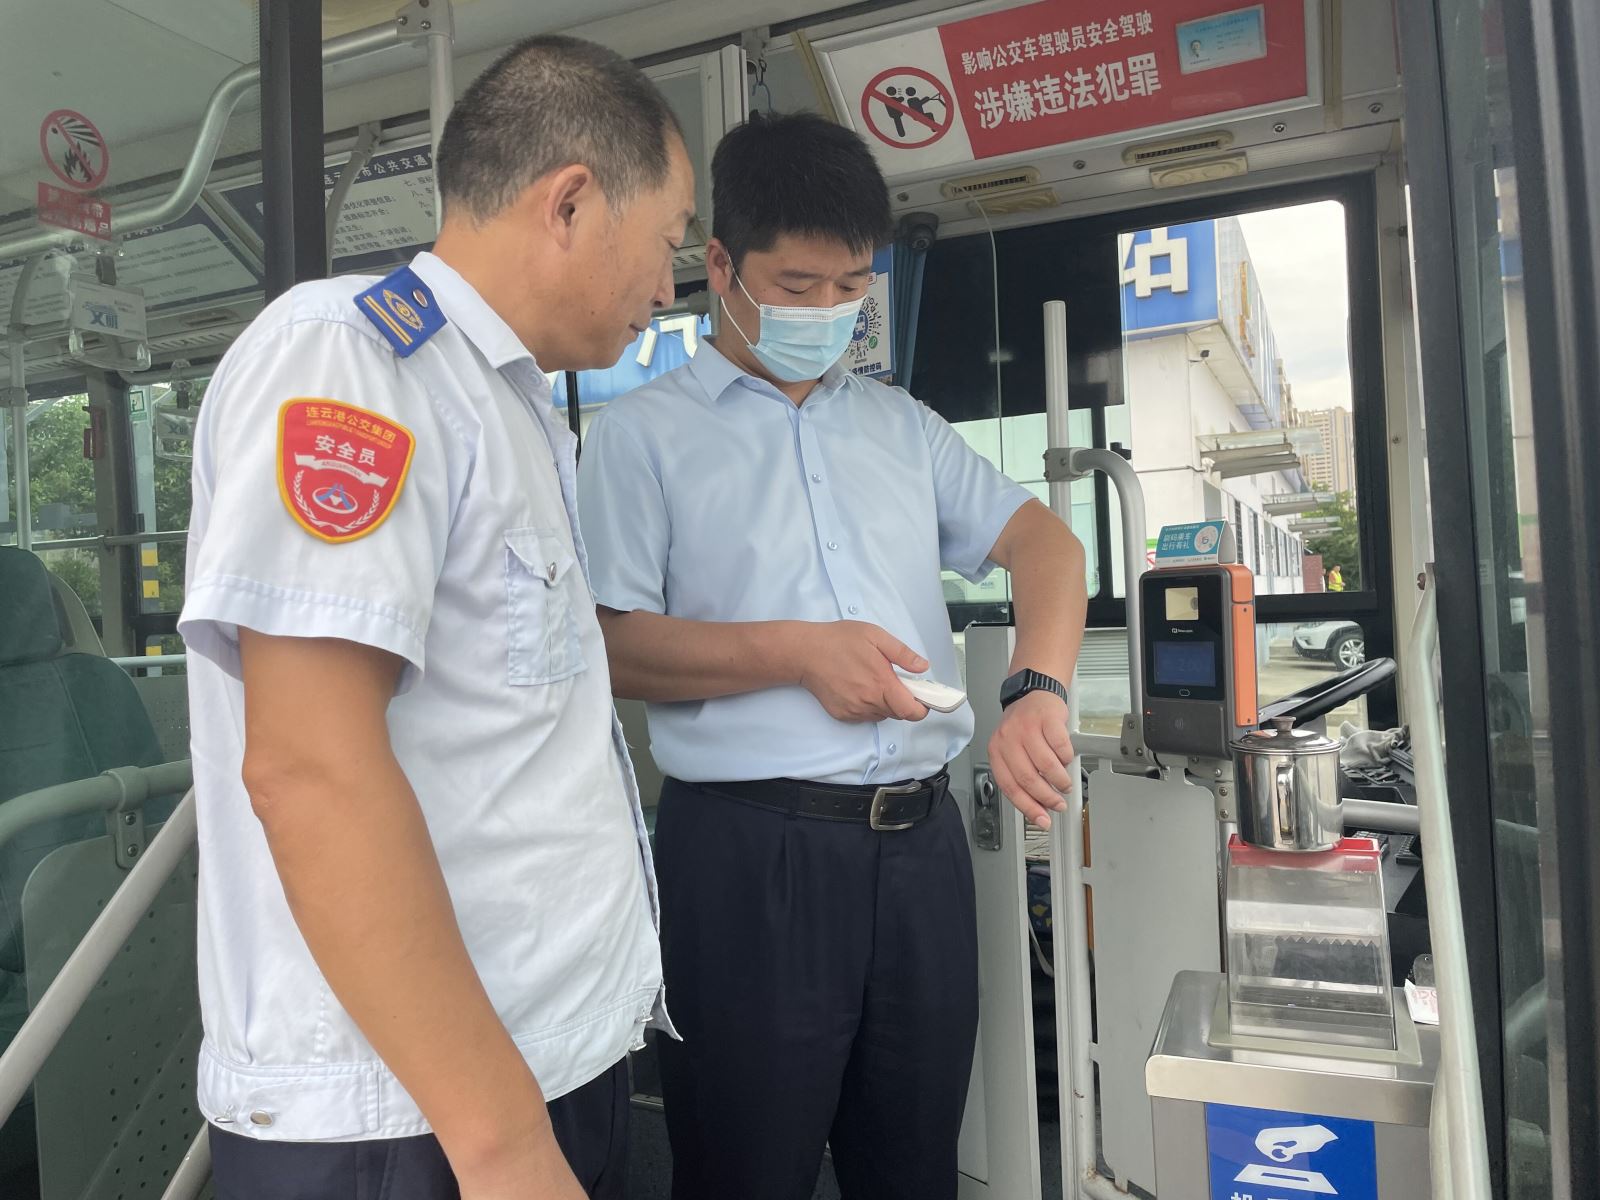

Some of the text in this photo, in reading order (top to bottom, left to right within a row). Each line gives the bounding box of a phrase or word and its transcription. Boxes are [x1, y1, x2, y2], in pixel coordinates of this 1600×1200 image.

[961, 10, 1154, 75] 影响公交车驾驶员安全驾驶
[973, 52, 1161, 129] 涉嫌违法犯罪
[324, 152, 432, 185] 连市公共交通
[849, 362, 882, 376] 疫情防控码
[305, 406, 397, 443] 连云港公交集团
[314, 434, 376, 466] 安全员
